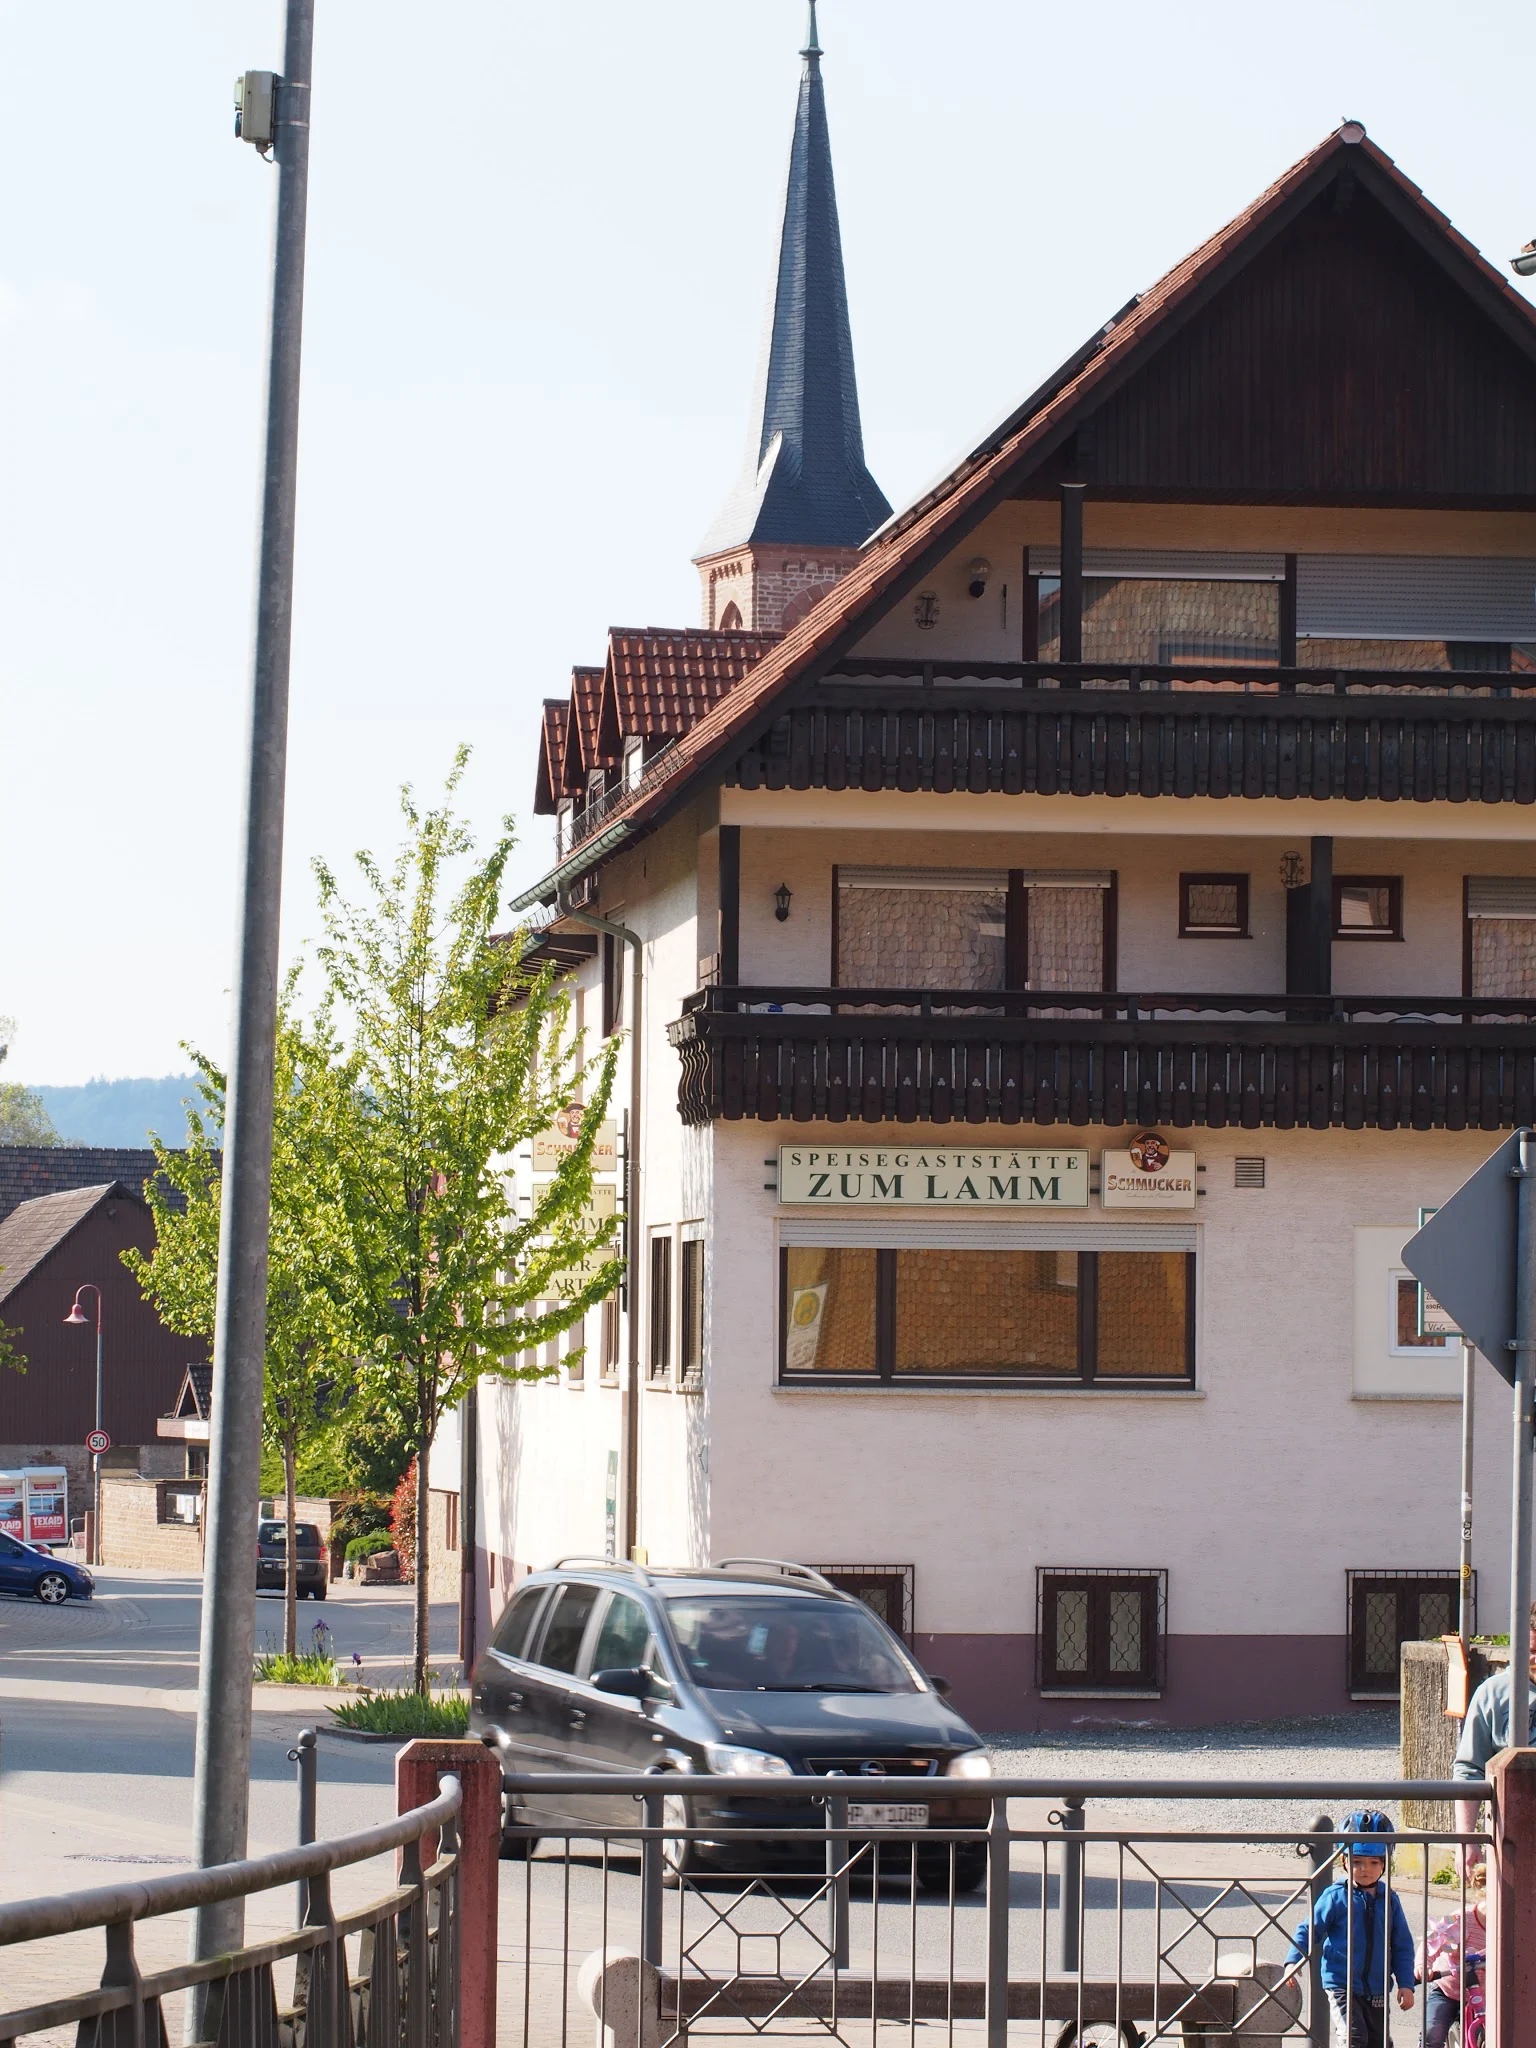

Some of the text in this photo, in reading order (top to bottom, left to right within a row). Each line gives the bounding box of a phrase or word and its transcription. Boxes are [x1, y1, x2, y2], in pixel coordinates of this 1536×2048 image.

[791, 1152, 1079, 1169] SPEISEGASTSTÄTTE
[807, 1173, 1063, 1200] ZUM LAMM
[1107, 1175, 1192, 1191] SCHMUCKER
[92, 1436, 104, 1447] 50
[32, 1515, 63, 1526] TEXAID
